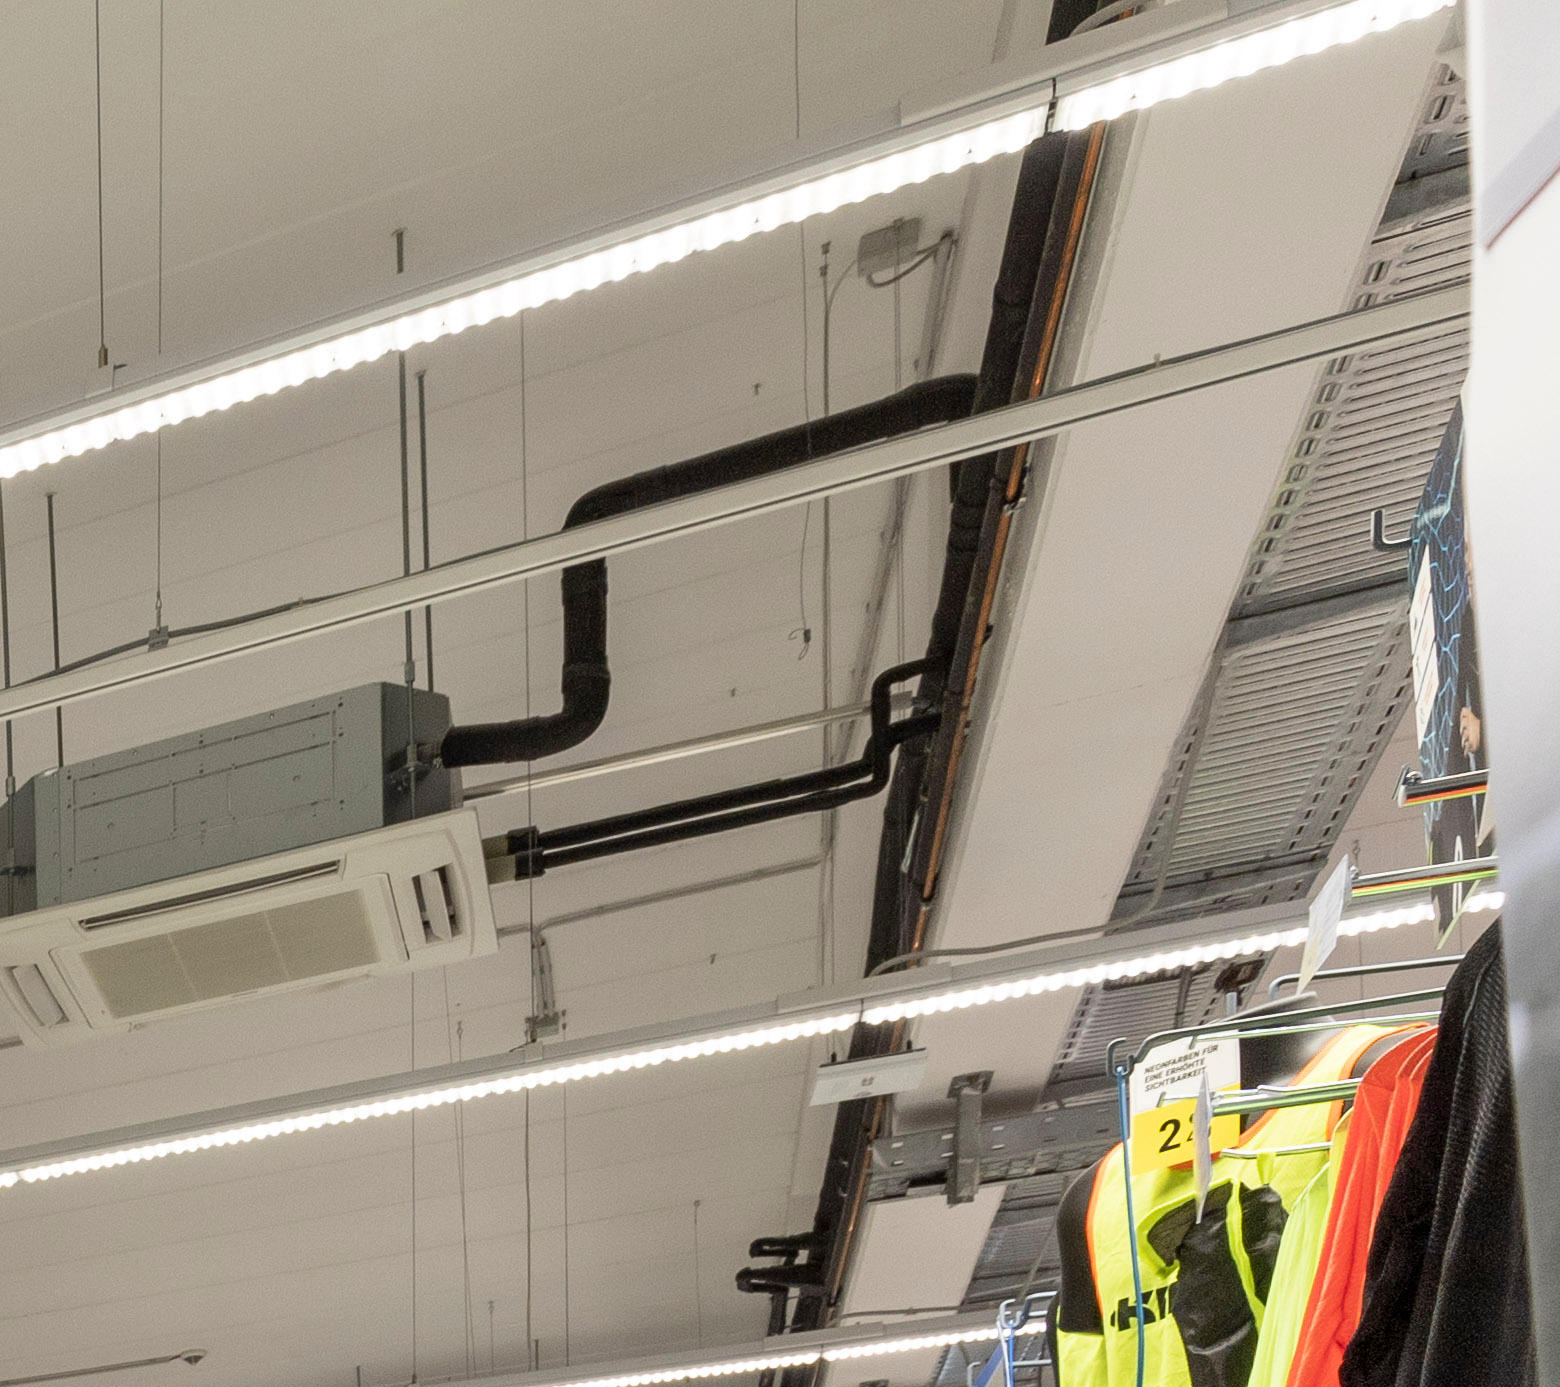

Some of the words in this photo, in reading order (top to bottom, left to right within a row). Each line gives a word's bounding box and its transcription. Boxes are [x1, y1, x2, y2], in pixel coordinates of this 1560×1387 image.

[1144, 1052, 1198, 1076] NEONFARBEN
[1201, 1043, 1219, 1058] FÜR
[1144, 1071, 1163, 1083] EINE
[1164, 1057, 1206, 1077] ERHÖHTE
